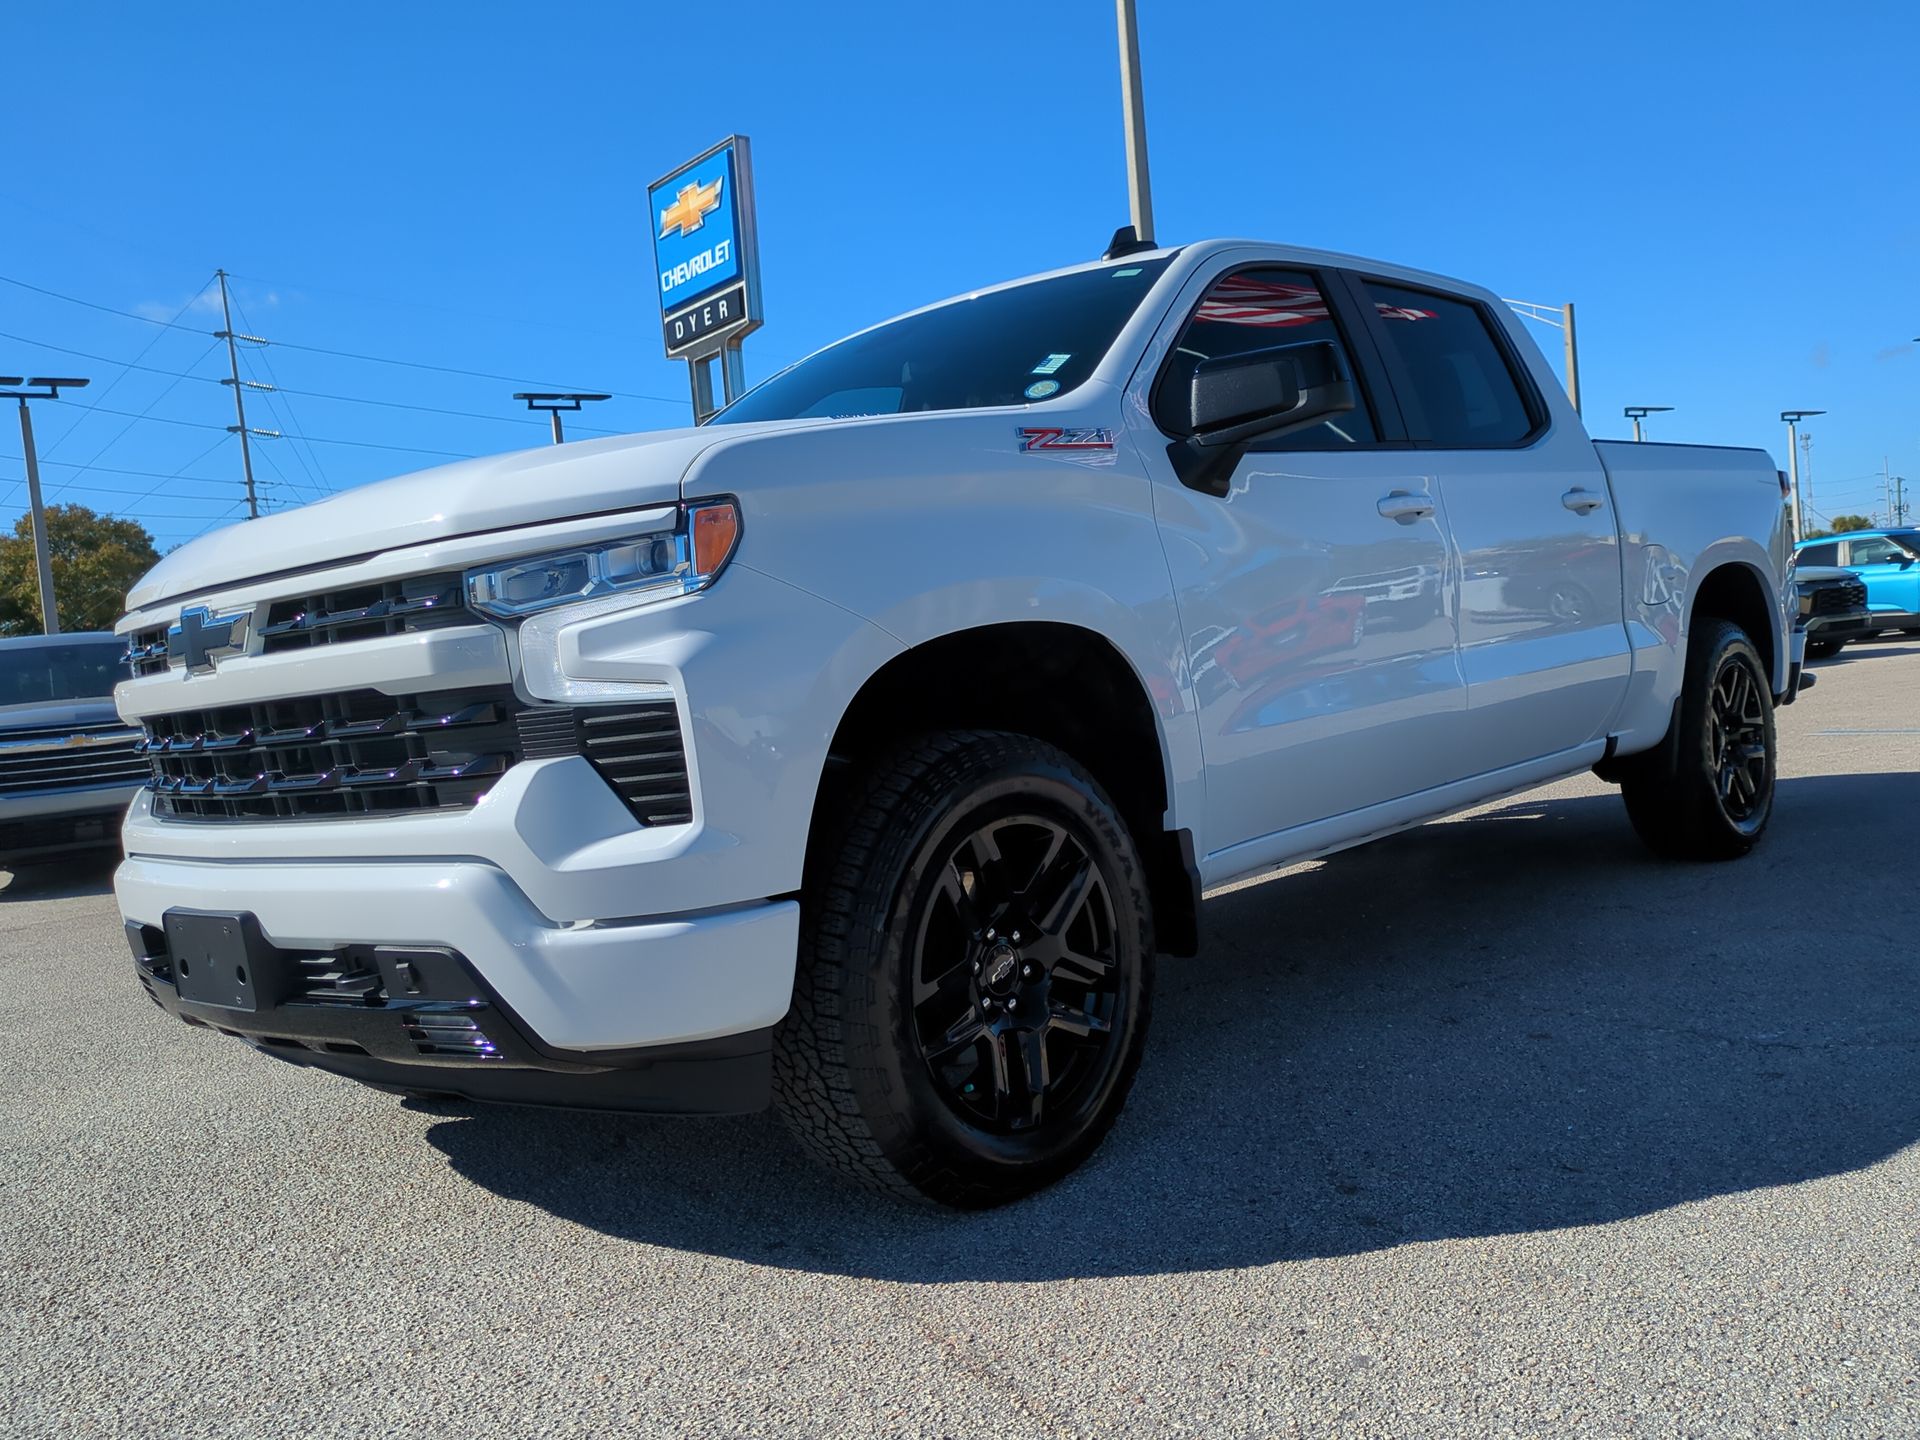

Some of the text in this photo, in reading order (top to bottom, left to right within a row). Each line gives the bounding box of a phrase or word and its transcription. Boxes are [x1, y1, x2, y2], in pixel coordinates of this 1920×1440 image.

[661, 239, 731, 293] CHEVROLET
[675, 299, 729, 339] DYER
[1015, 426, 1115, 453] Z71
